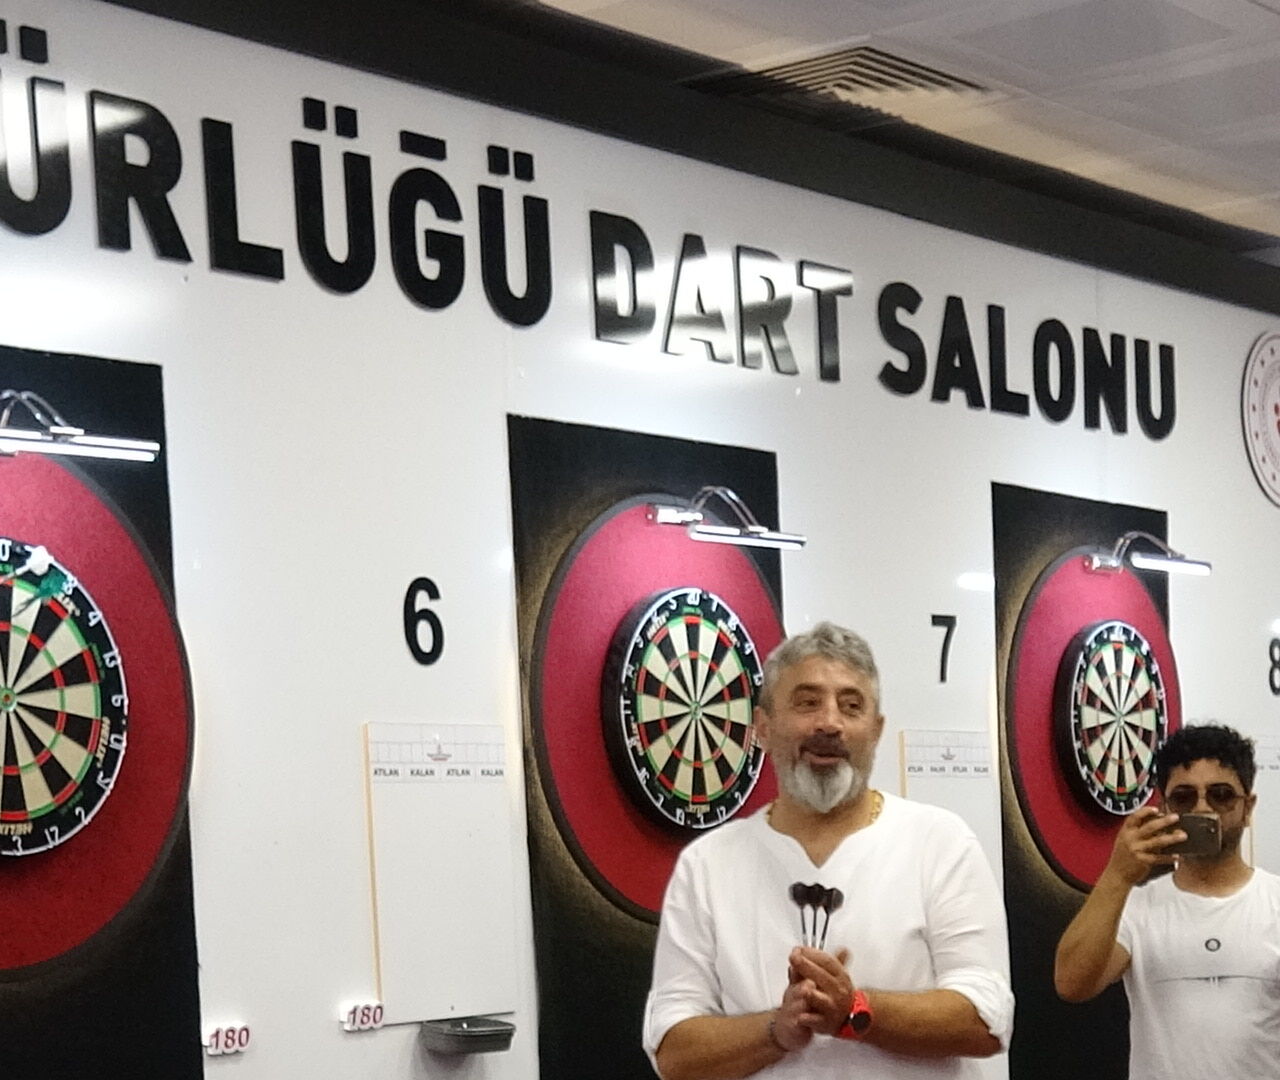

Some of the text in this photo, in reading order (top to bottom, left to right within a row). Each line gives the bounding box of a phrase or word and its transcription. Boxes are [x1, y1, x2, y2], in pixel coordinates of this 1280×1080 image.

[589, 209, 854, 382] DART
[877, 281, 1177, 442] SALONU
[403, 576, 445, 667] 6
[931, 614, 957, 683] 7
[209, 1026, 251, 1051] 180
[348, 1004, 384, 1027] 180
